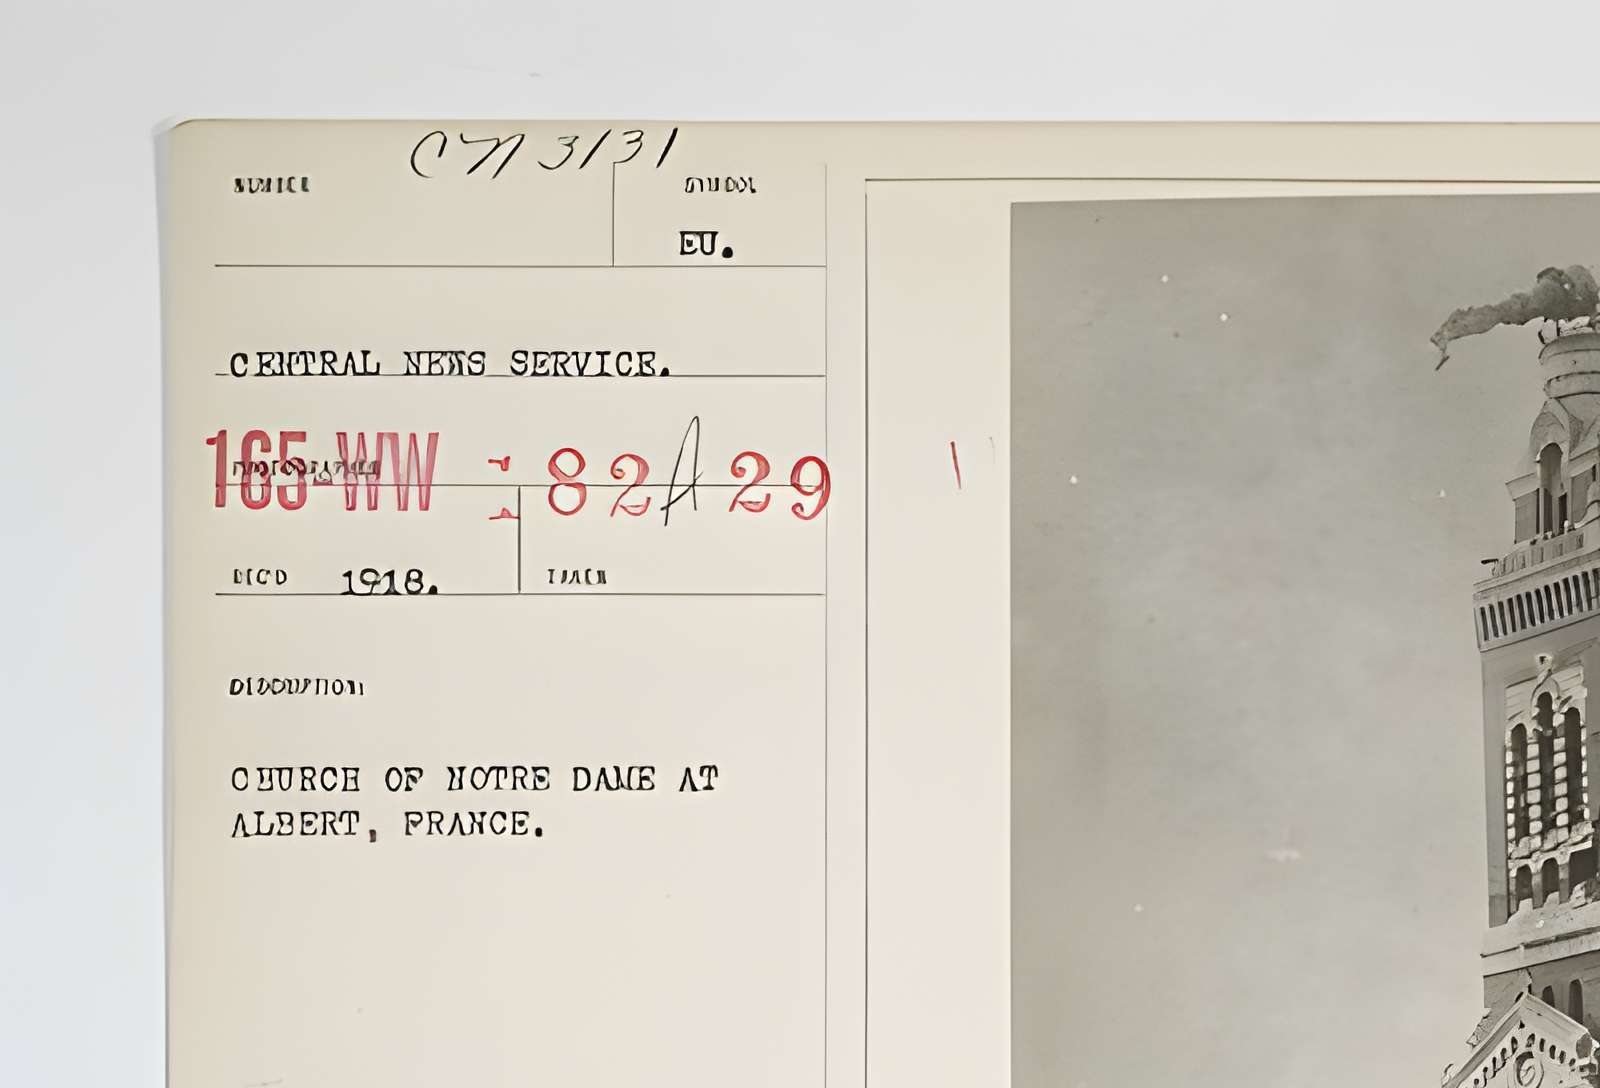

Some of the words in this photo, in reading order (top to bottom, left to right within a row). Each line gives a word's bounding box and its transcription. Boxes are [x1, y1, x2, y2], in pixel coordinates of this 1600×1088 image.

[678, 230, 734, 259] EU.
[229, 349, 381, 378] CENTRAL
[509, 349, 671, 378] SERVICE.
[341, 567, 439, 595] 1918.
[231, 765, 361, 793] CHURCH
[384, 765, 425, 793] OF
[445, 764, 551, 793] NOTRE
[572, 764, 656, 793] DAME
[678, 764, 720, 793] AT
[230, 809, 378, 844] ALBERT,
[403, 810, 544, 838] FRANCE.
